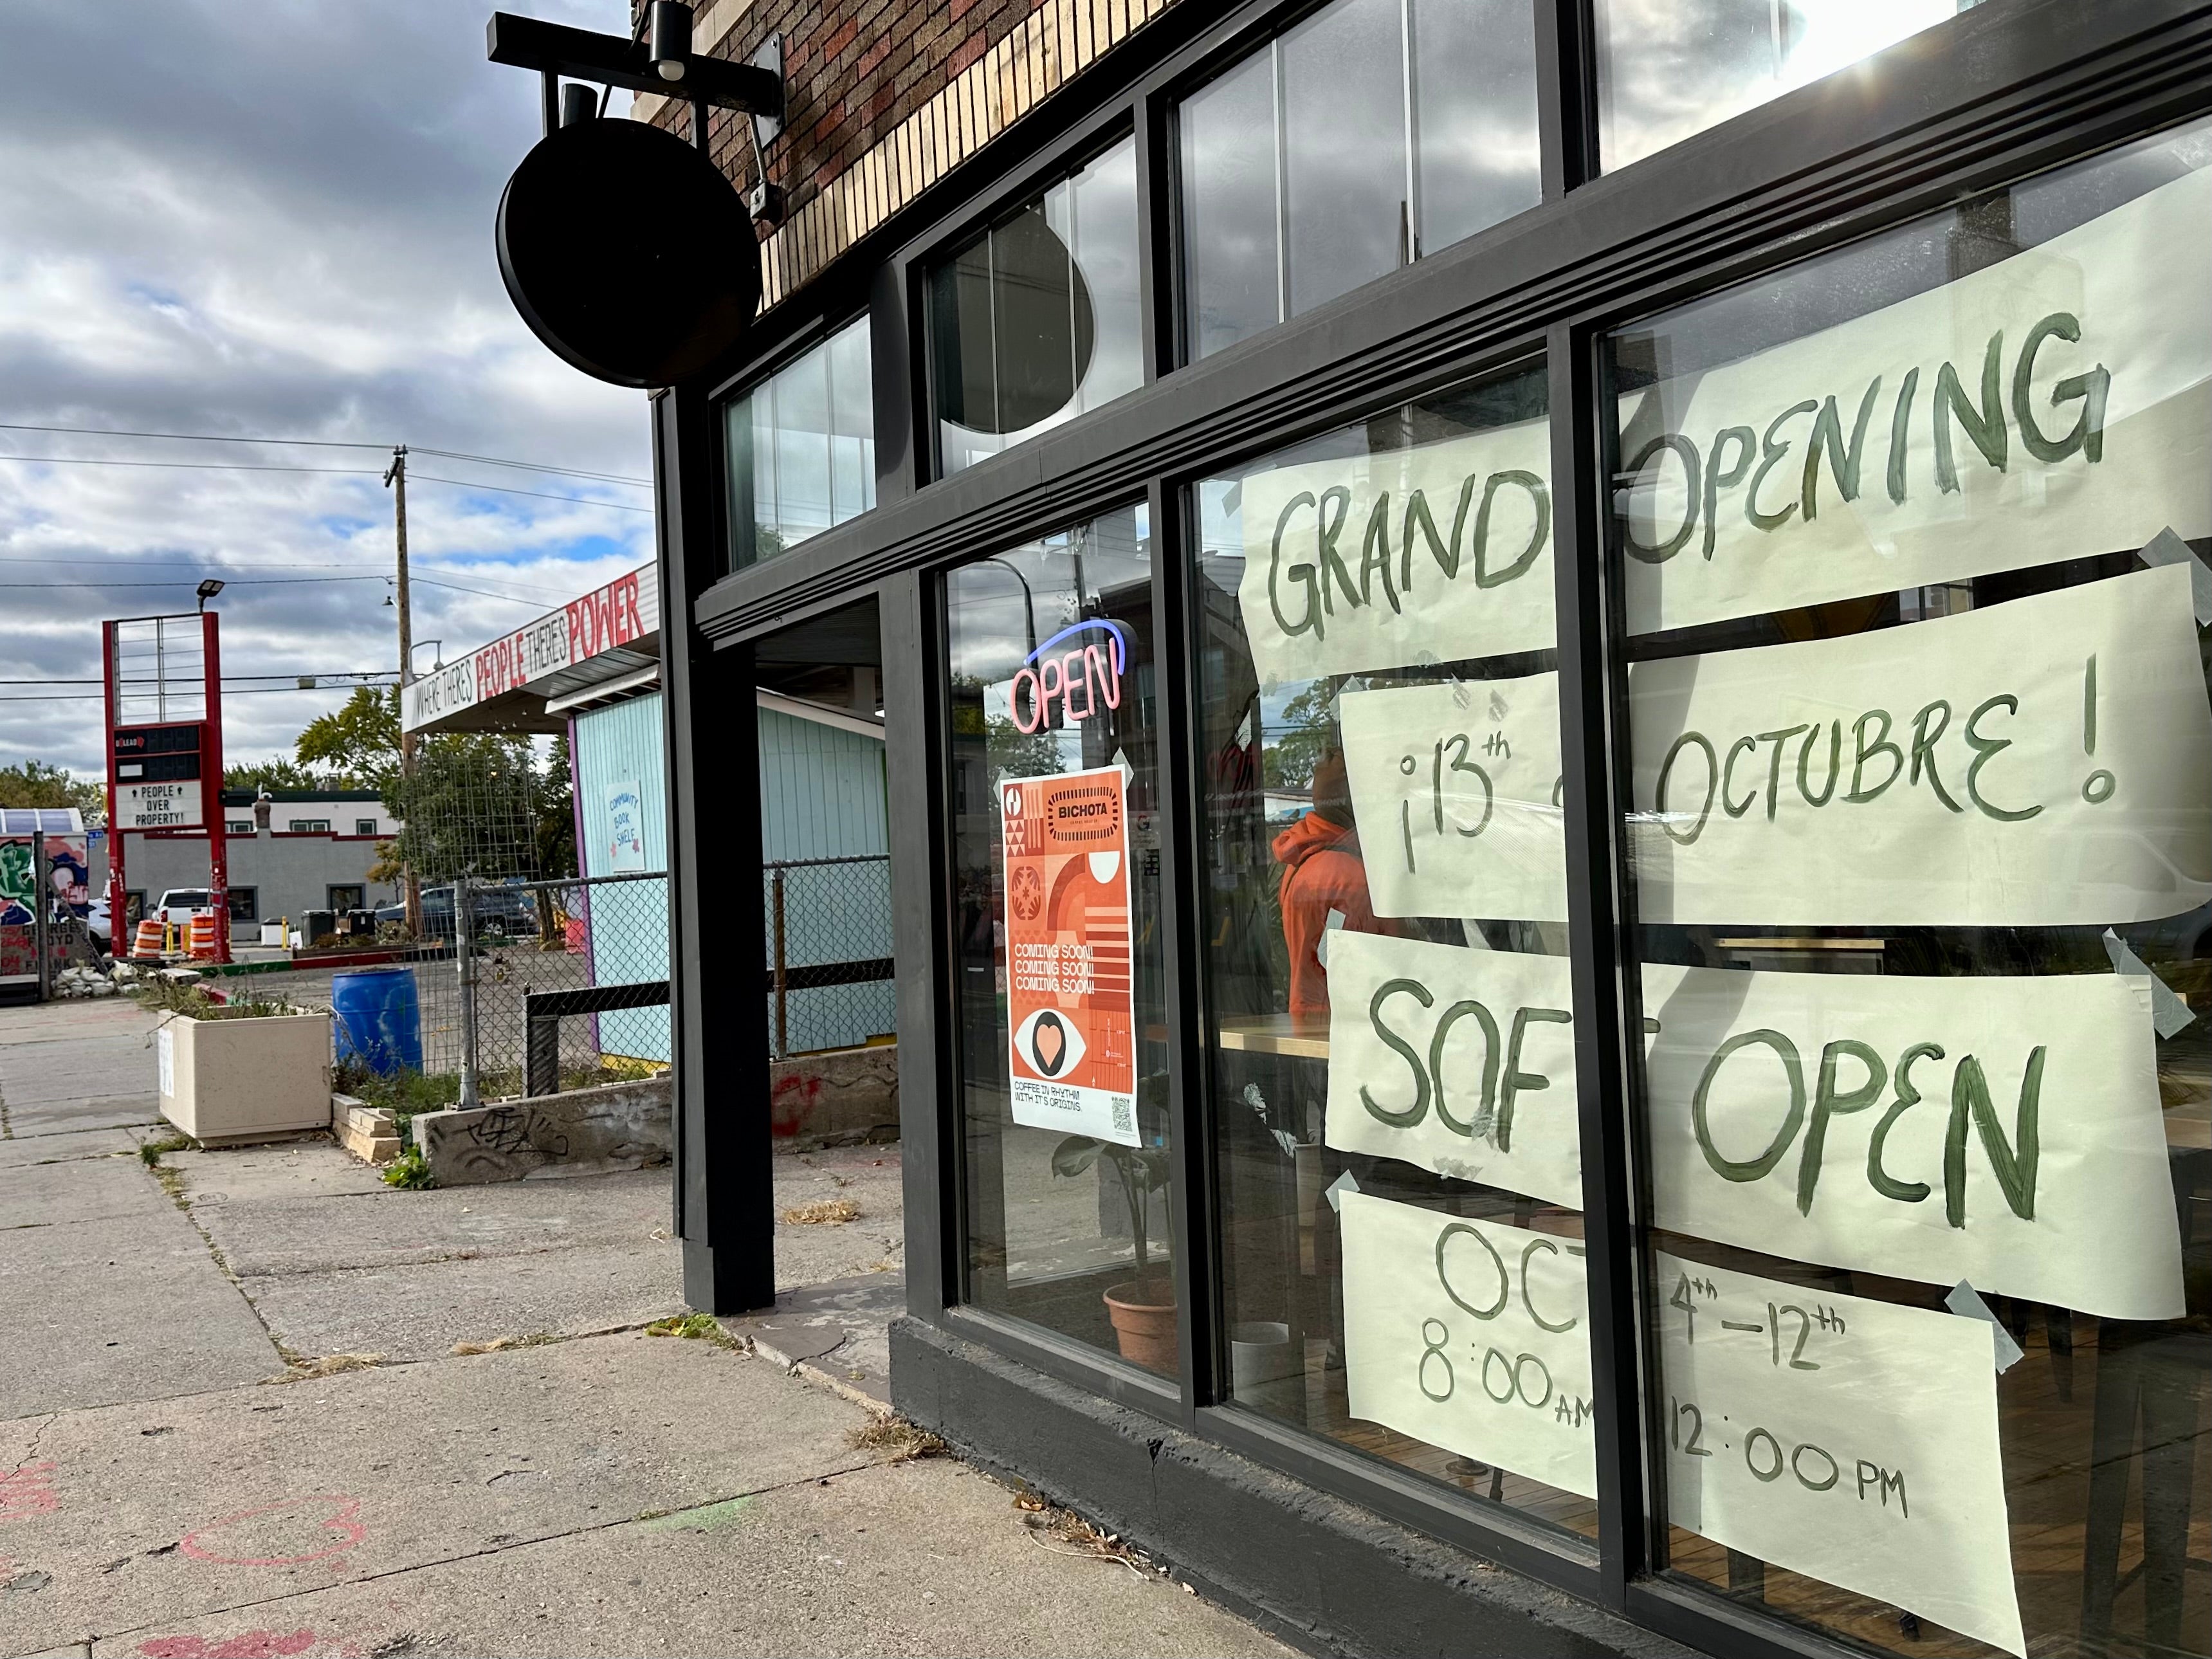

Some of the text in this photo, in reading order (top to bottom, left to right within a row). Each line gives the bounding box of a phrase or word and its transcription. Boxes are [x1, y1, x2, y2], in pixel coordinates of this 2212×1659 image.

[1267, 311, 2111, 641] GRAND OPENING
[416, 676, 441, 719] WHERE
[476, 633, 527, 703] PEOPLE
[526, 616, 567, 673] THERE'S
[566, 573, 645, 665] POWER
[1010, 637, 1120, 735] OPEN
[142, 785, 174, 798] PEOPLE
[147, 800, 170, 811] OVER
[609, 792, 639, 811] COMMUNITY
[1059, 803, 1108, 818] BICHOTA
[136, 812, 184, 826] PROPERTY!
[614, 812, 630, 829] BOOK
[617, 829, 635, 847] SHELF
[1014, 943, 1093, 960] COMING SOON!
[1015, 959, 1094, 977] COMING SOON!
[1016, 976, 1095, 994] COMING SOON!
[1014, 1081, 1079, 1100] COFFEE IN RHYTHM
[1015, 1092, 1033, 1103] WITH
[1359, 978, 2046, 1229] SOF OPEN
[1856, 1458, 1908, 1519] PM
